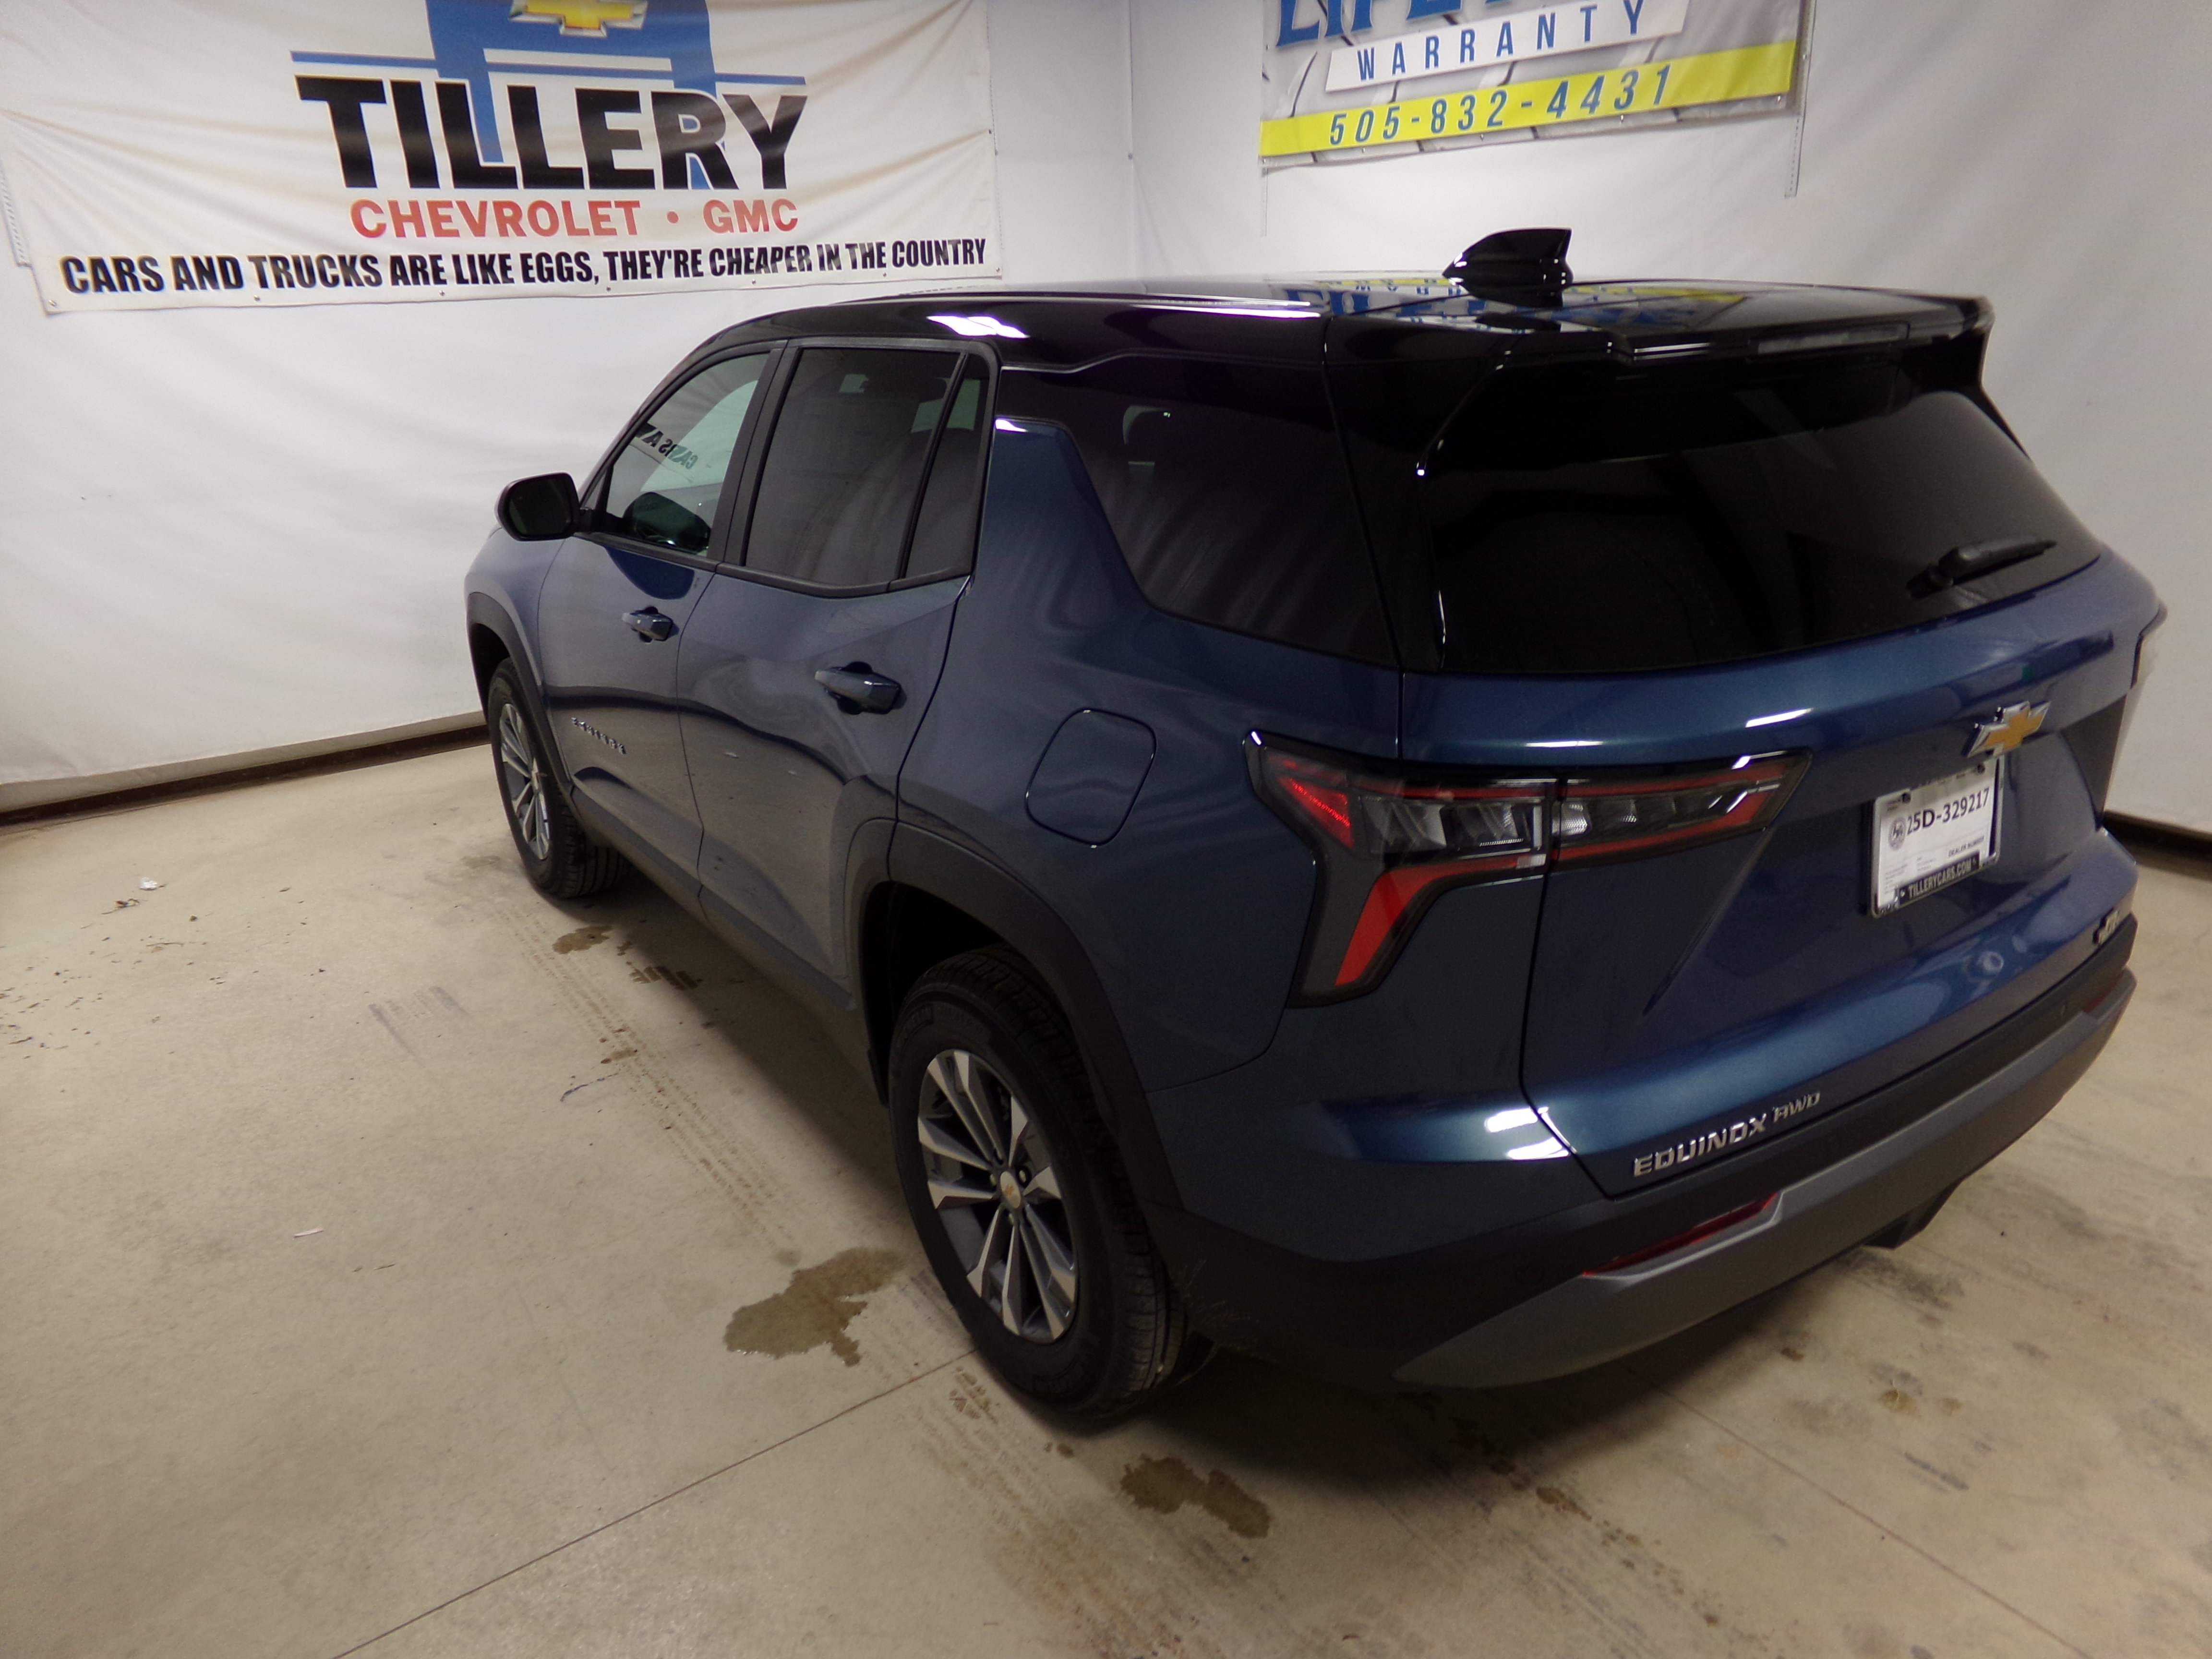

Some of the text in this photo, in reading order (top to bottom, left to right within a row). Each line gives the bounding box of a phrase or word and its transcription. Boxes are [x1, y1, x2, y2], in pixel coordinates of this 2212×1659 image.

[1357, 0, 1644, 82] WARRANTY
[295, 75, 807, 190] TILLERY
[1330, 66, 1670, 145] 505-832-4431
[350, 199, 798, 239] CHEVROLET GMC
[61, 239, 986, 293] CARS AND TRUCKS ARE LIKE EGGS, THEY'RE CHEAPER IN THE COUNTRY
[1907, 786, 1990, 835] 25D-329217
[1909, 856, 1972, 899] TILLERYCARS.COM
[1633, 1091, 1821, 1177] EQUINOX AWD
